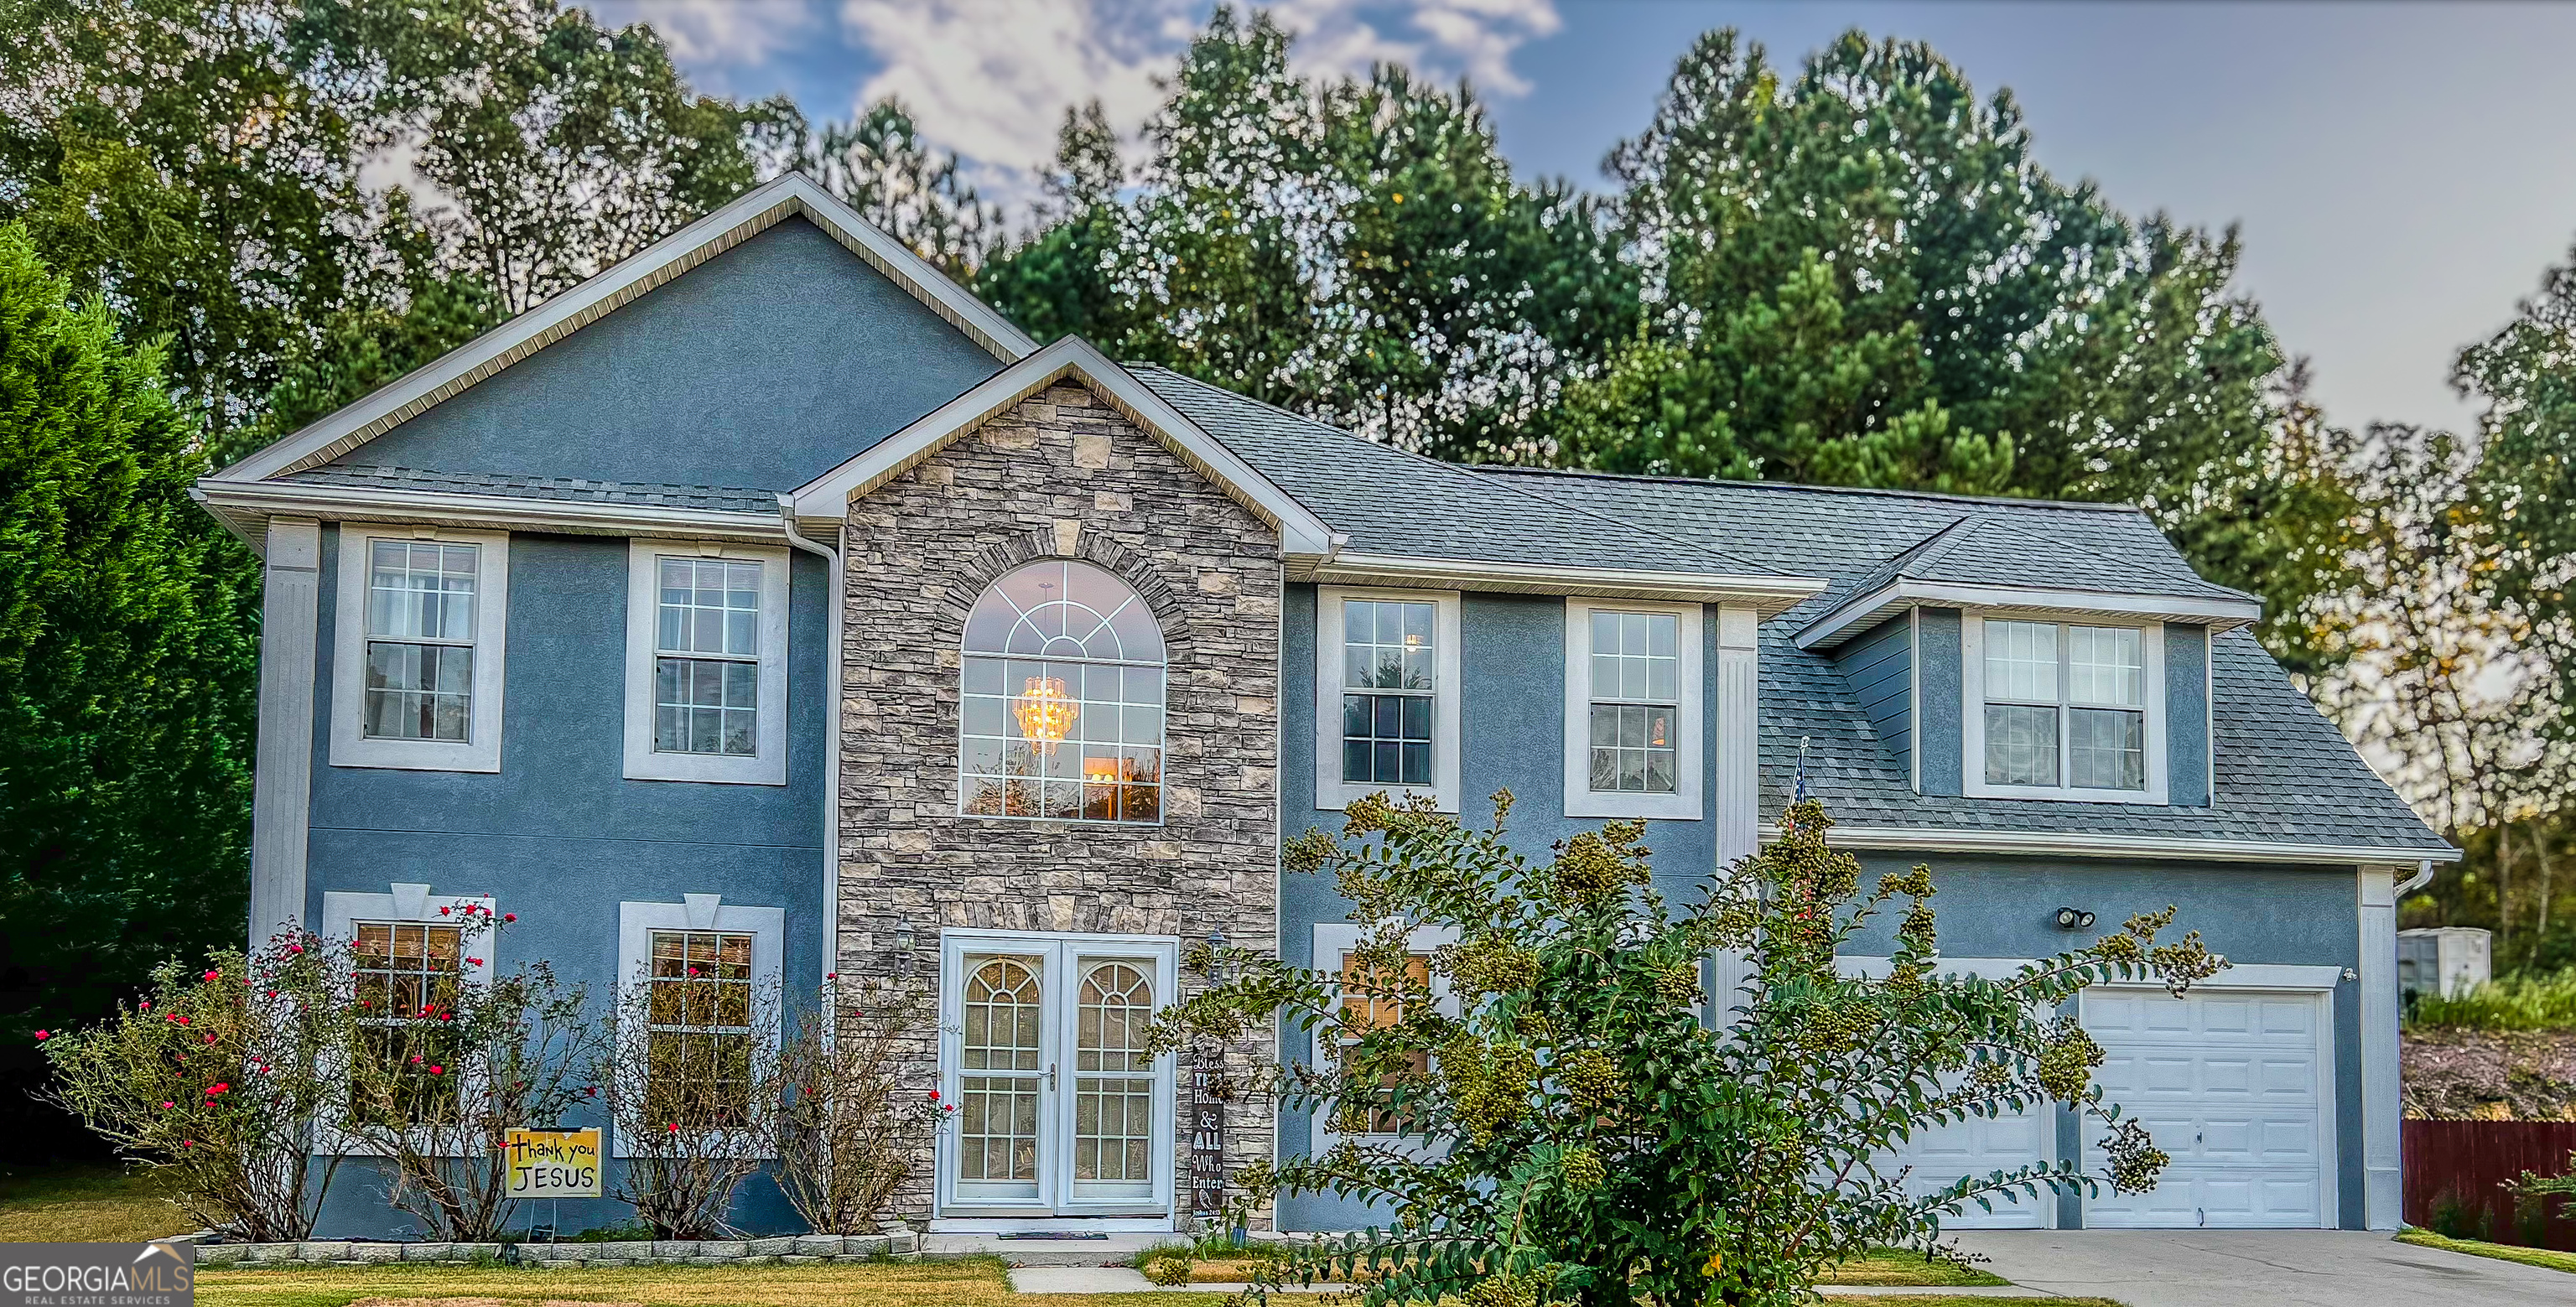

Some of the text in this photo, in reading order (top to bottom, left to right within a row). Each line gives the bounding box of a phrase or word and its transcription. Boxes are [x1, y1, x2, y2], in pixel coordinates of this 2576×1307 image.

[1193, 1054, 1223, 1069] Bless
[1200, 1111, 1218, 1130] &
[1193, 1132, 1221, 1149] ALL
[569, 1144, 595, 1164] you
[1192, 1154, 1221, 1172] Who
[513, 1166, 595, 1191] JESUS
[1192, 1176, 1223, 1189] Enter
